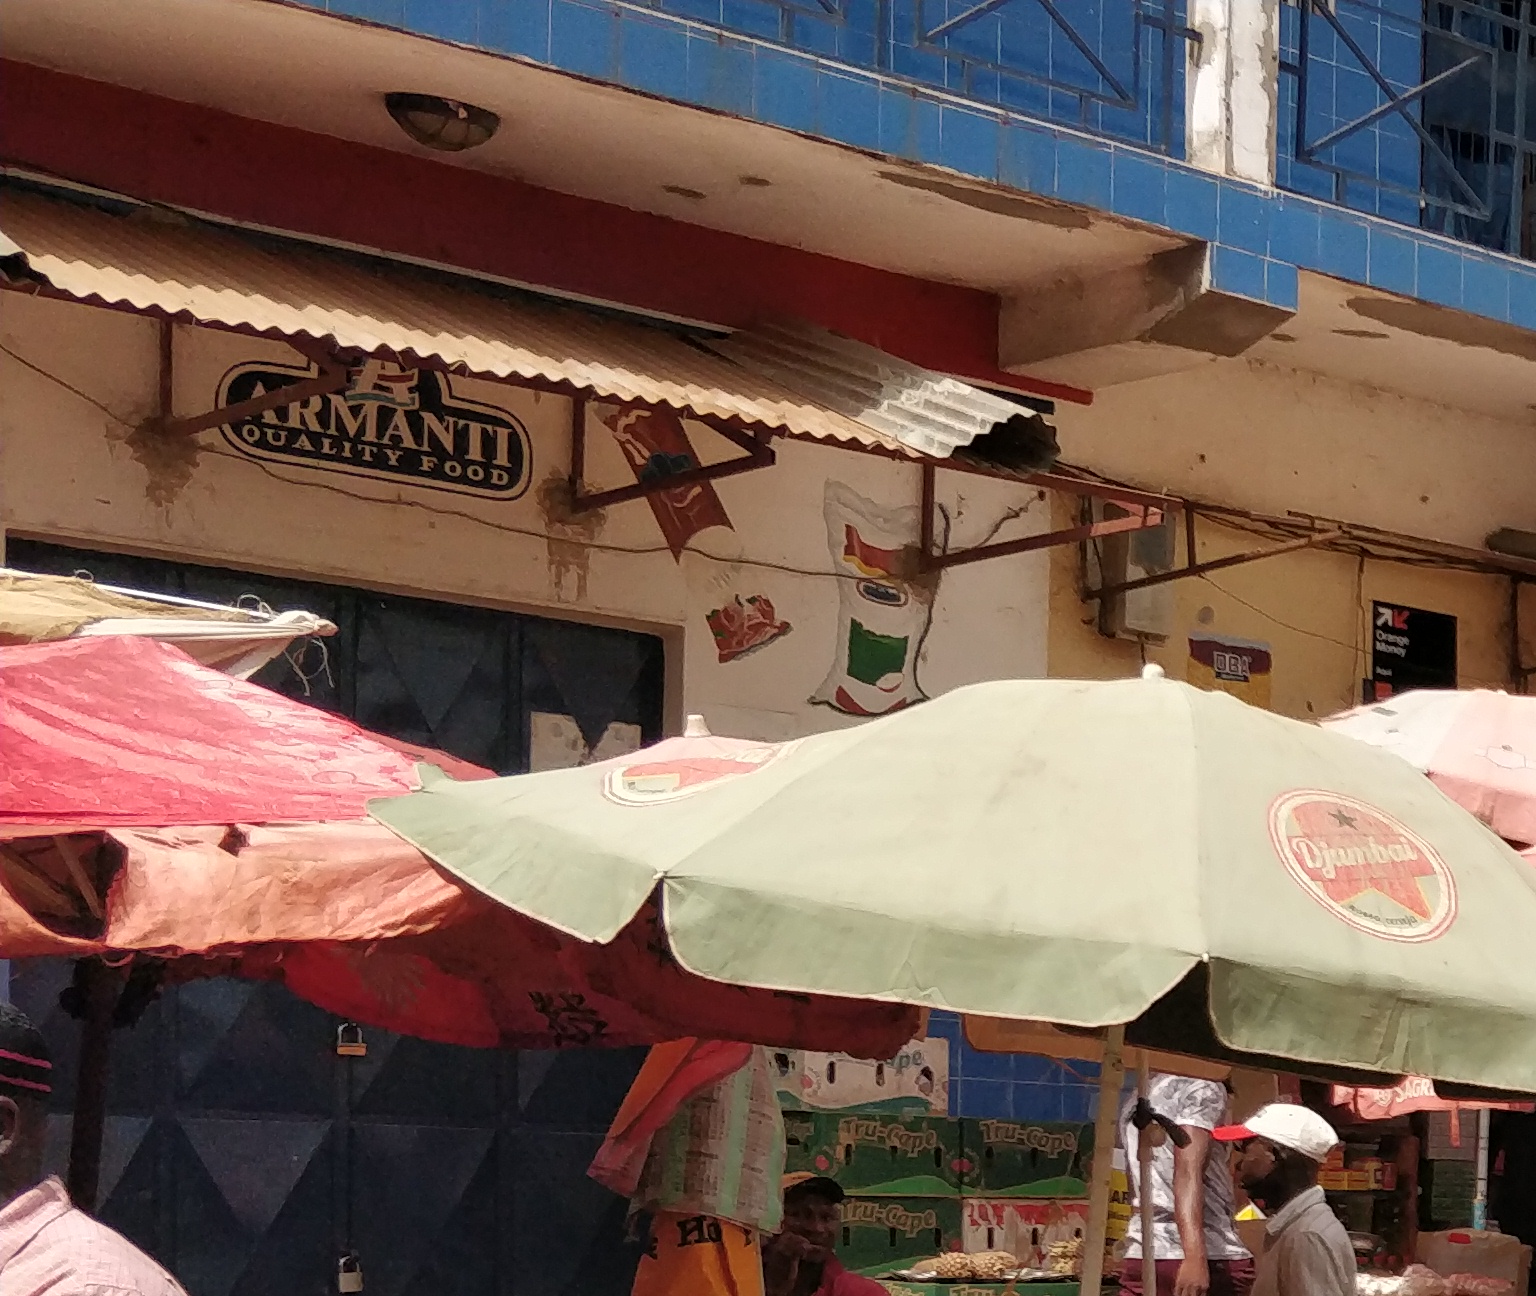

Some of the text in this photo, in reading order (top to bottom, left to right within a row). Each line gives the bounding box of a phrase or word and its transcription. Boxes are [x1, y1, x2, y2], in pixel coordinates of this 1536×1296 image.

[241, 423, 511, 487] QUALITY FOOD
[1375, 629, 1410, 647] Orange
[1375, 641, 1407, 658] Money
[1291, 836, 1419, 879] Djumbai
